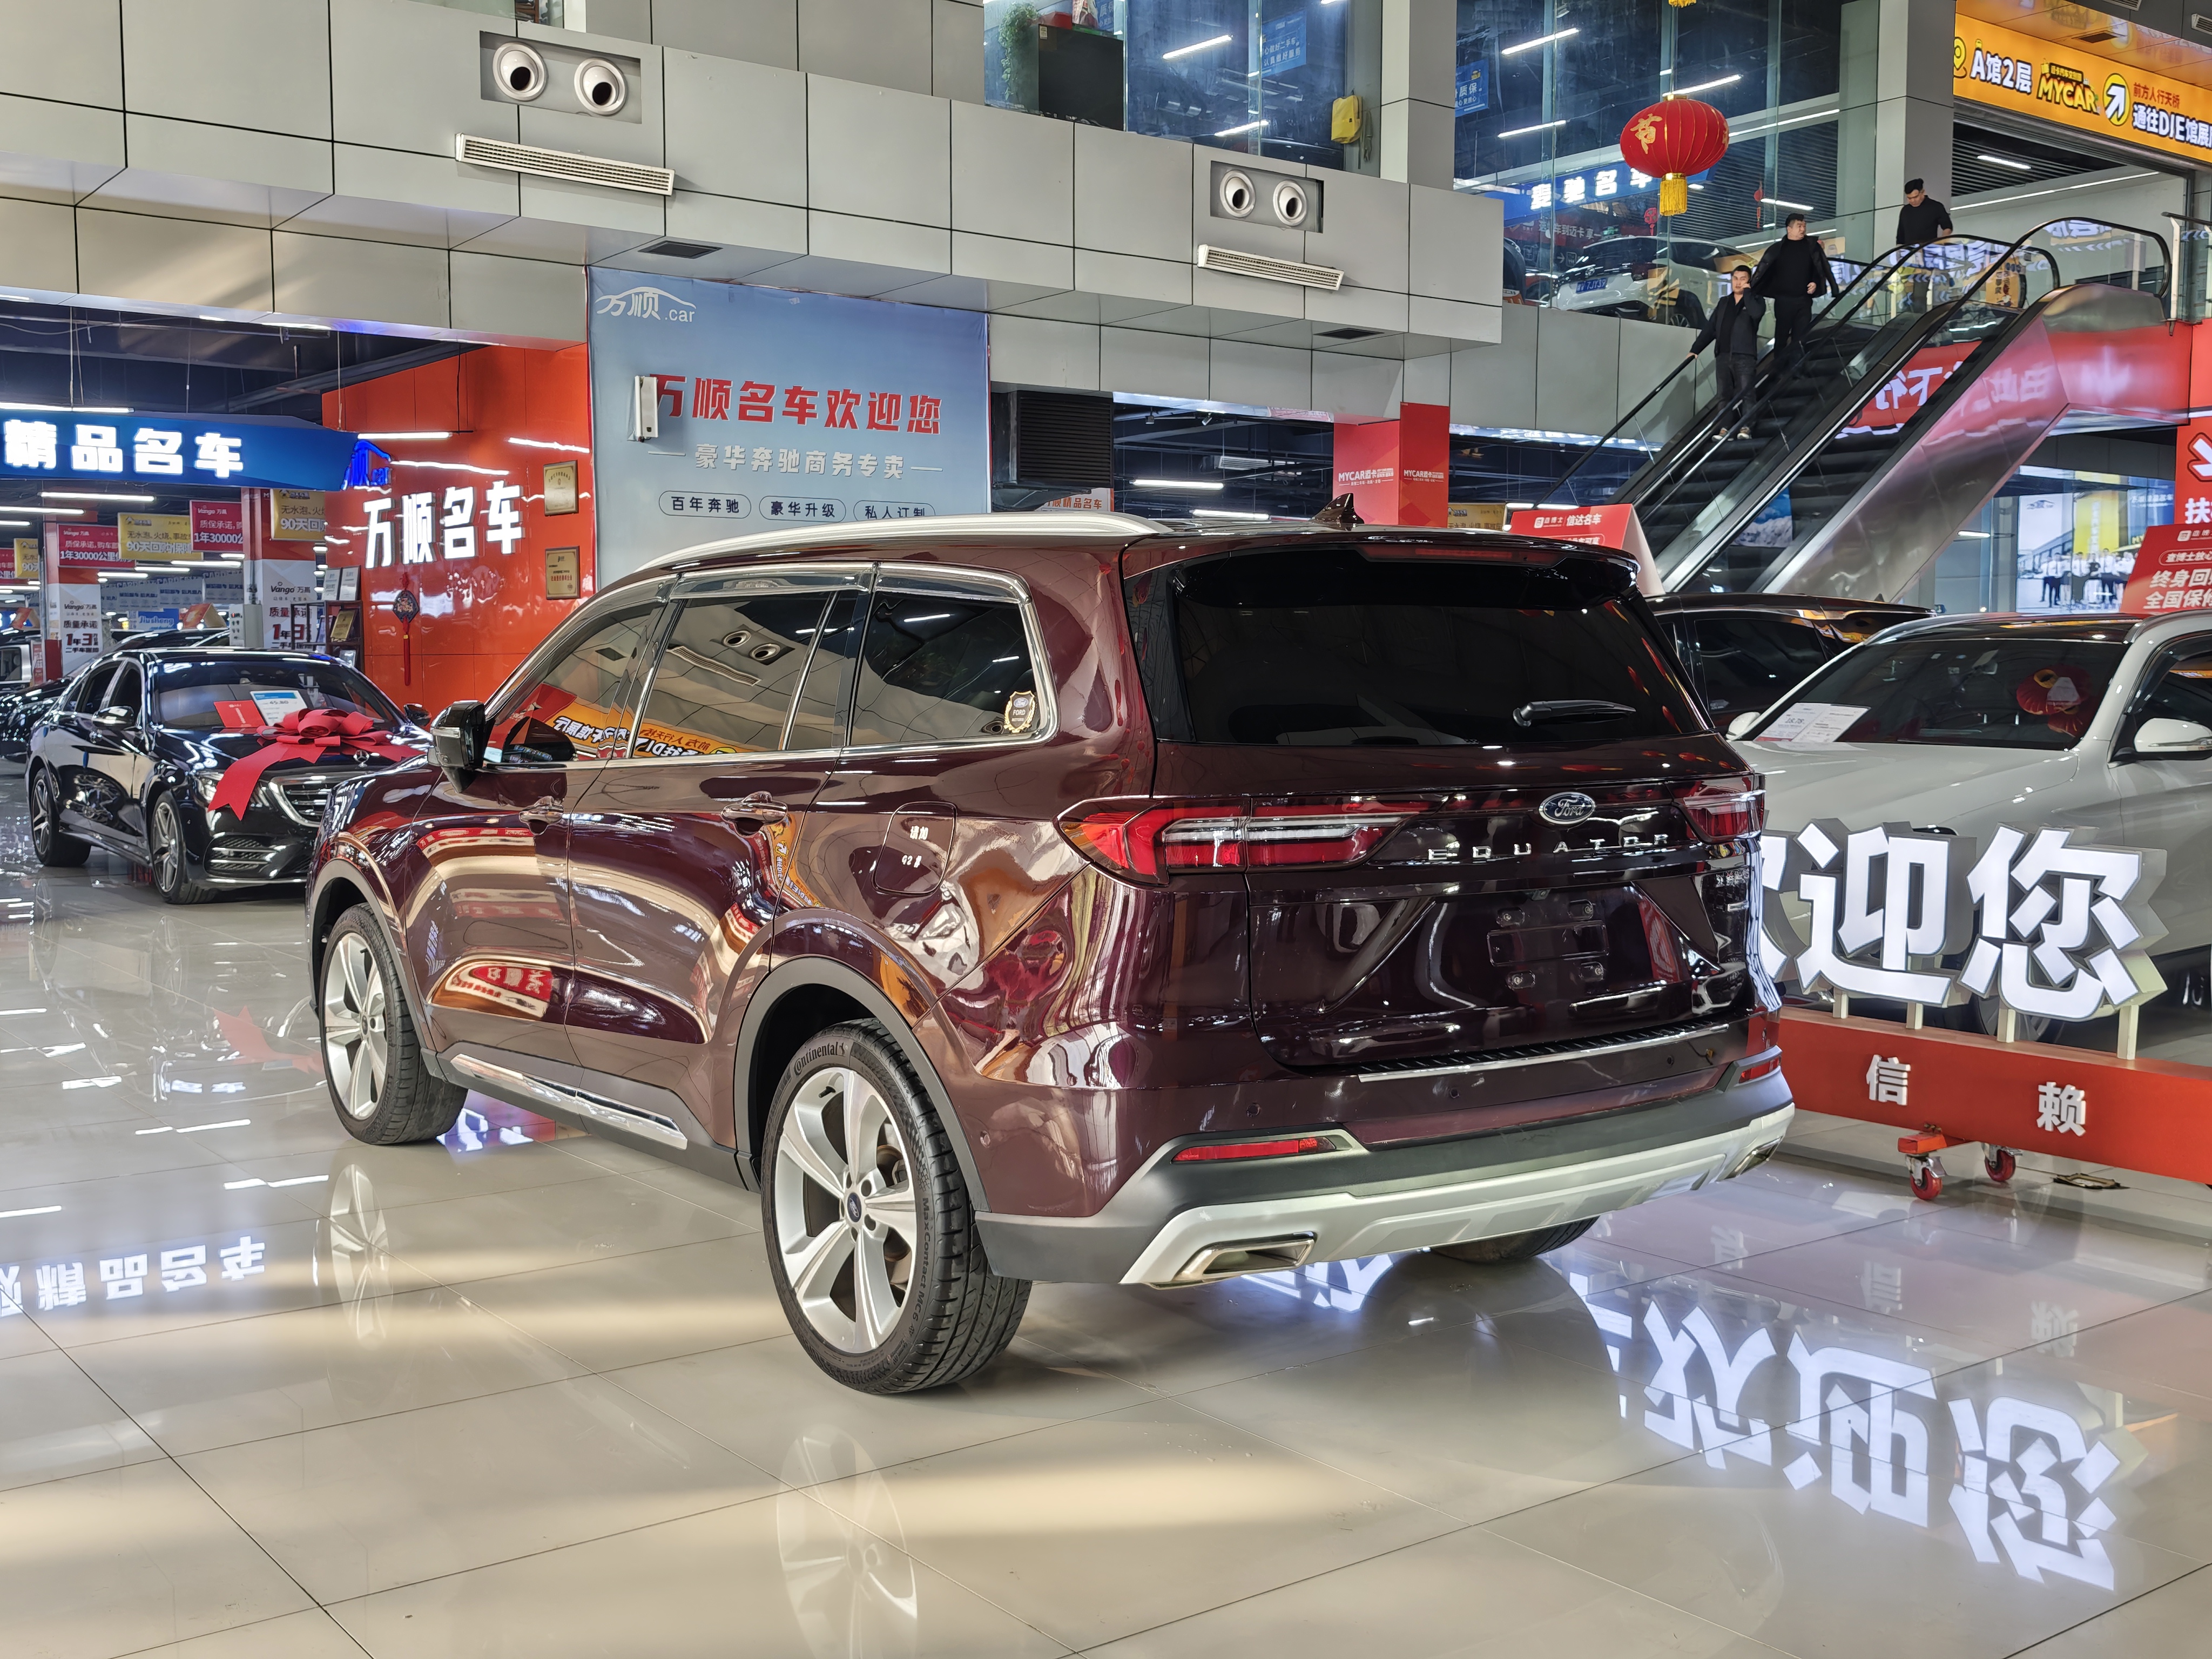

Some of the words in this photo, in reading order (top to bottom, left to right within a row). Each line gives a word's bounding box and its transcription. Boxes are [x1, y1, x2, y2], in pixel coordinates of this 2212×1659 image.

[1970, 49, 2033, 94] A馆2层
[2037, 75, 2098, 114] MYCAR
[2133, 82, 2180, 109] 前方人行天桥
[649, 373, 942, 435] 万顺名车欢迎您
[4, 419, 244, 479] 精品名车
[694, 443, 905, 480] 豪华奔驰商务专卖
[363, 480, 523, 570] 万顺名车
[671, 496, 740, 514] 百年奔驰
[771, 501, 835, 518] 豪华升级
[865, 505, 925, 520] 私人订制
[1567, 513, 1602, 527] 信达名车
[2184, 497, 2212, 524] 扶
[2149, 568, 2212, 588] 终身回
[1554, 798, 1586, 818] Ford
[1428, 833, 1669, 860] EQUATOR
[794, 1041, 839, 1076] Continental
[920, 1197, 930, 1289] MaxContact
